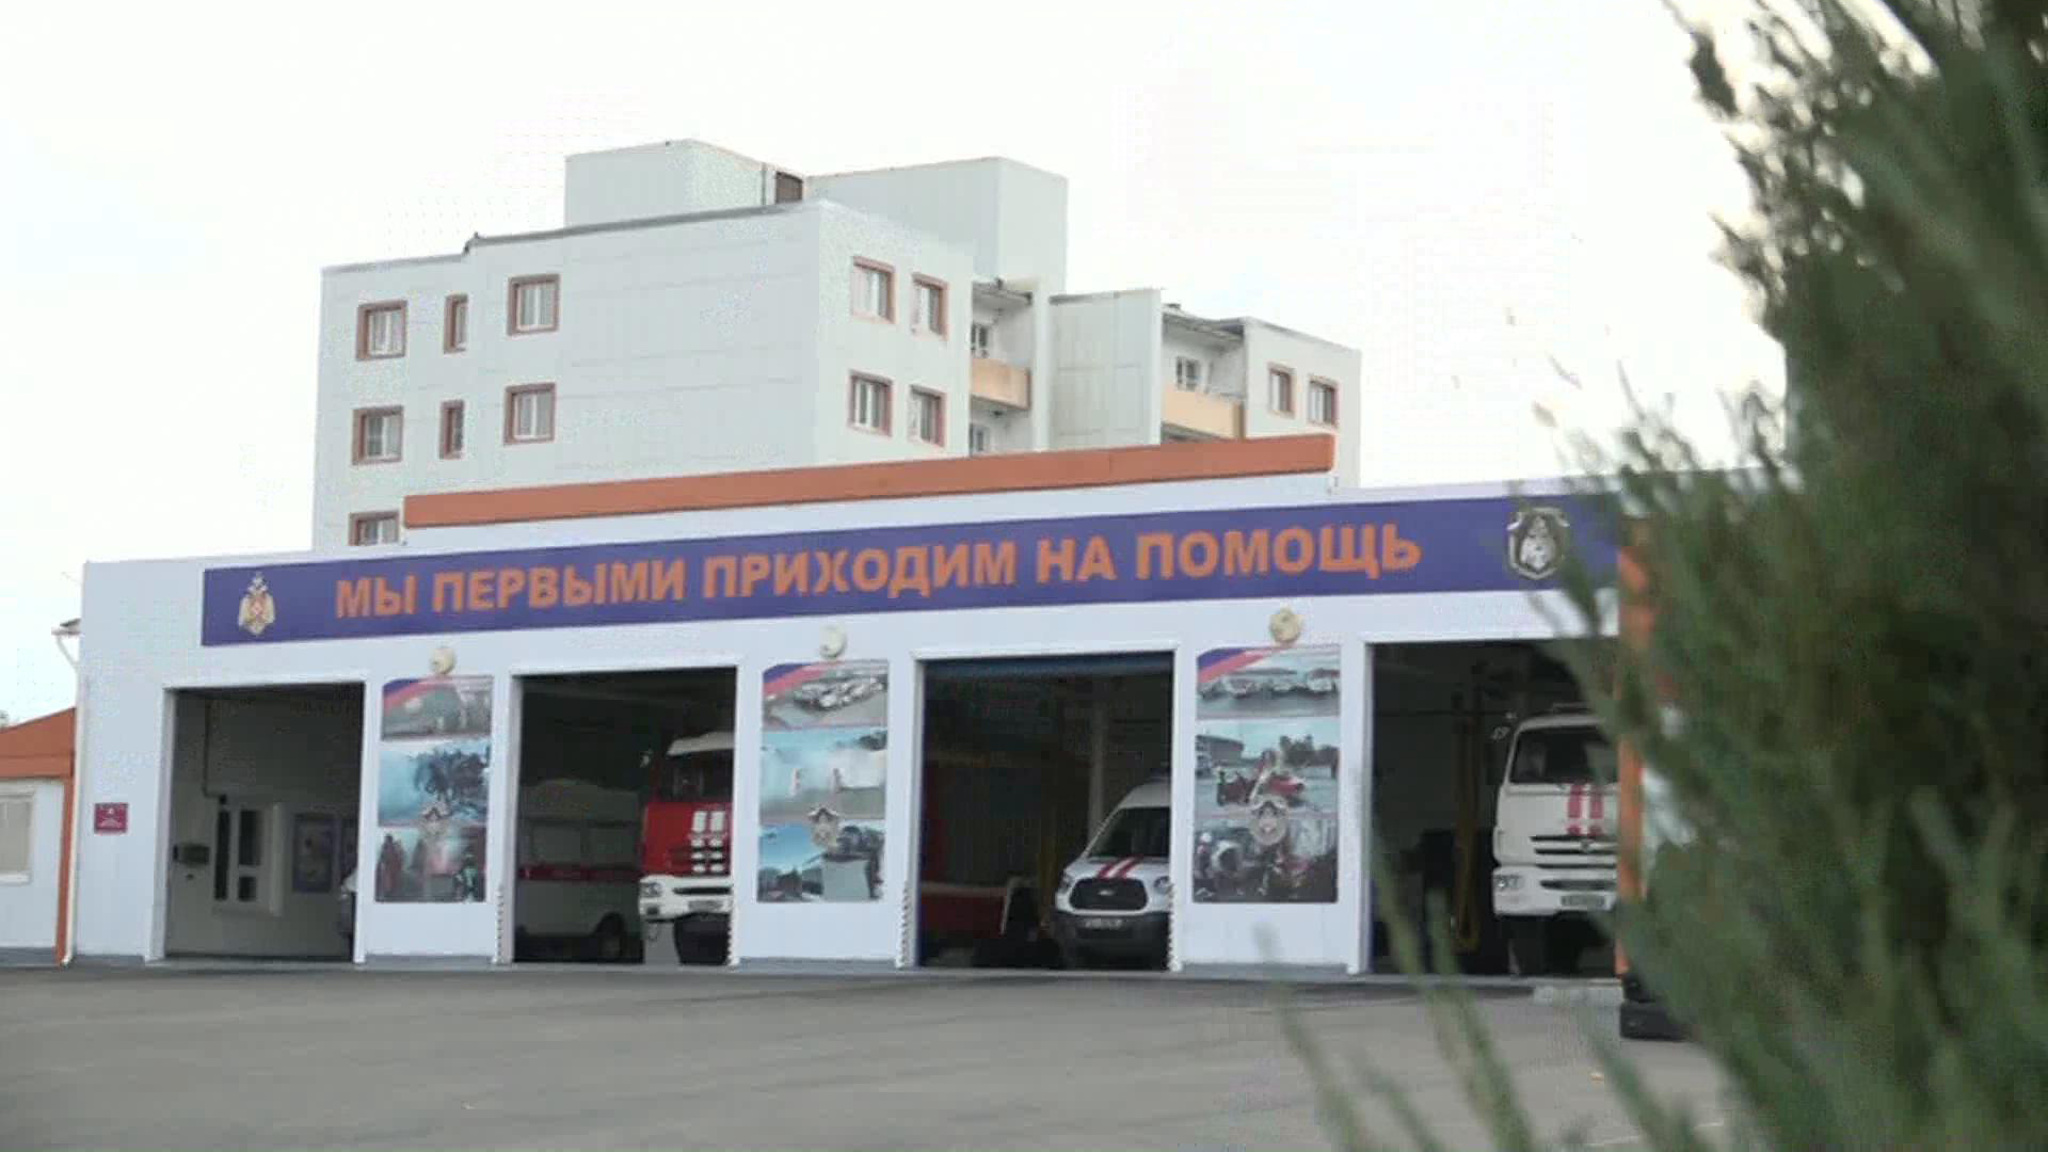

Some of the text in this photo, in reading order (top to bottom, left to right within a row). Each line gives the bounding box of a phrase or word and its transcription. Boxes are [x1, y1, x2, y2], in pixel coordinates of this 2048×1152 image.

[336, 523, 1422, 618] МЫ ПЕРВЫМИ ПРИХОДИМ НА ПОМОЩЬ
